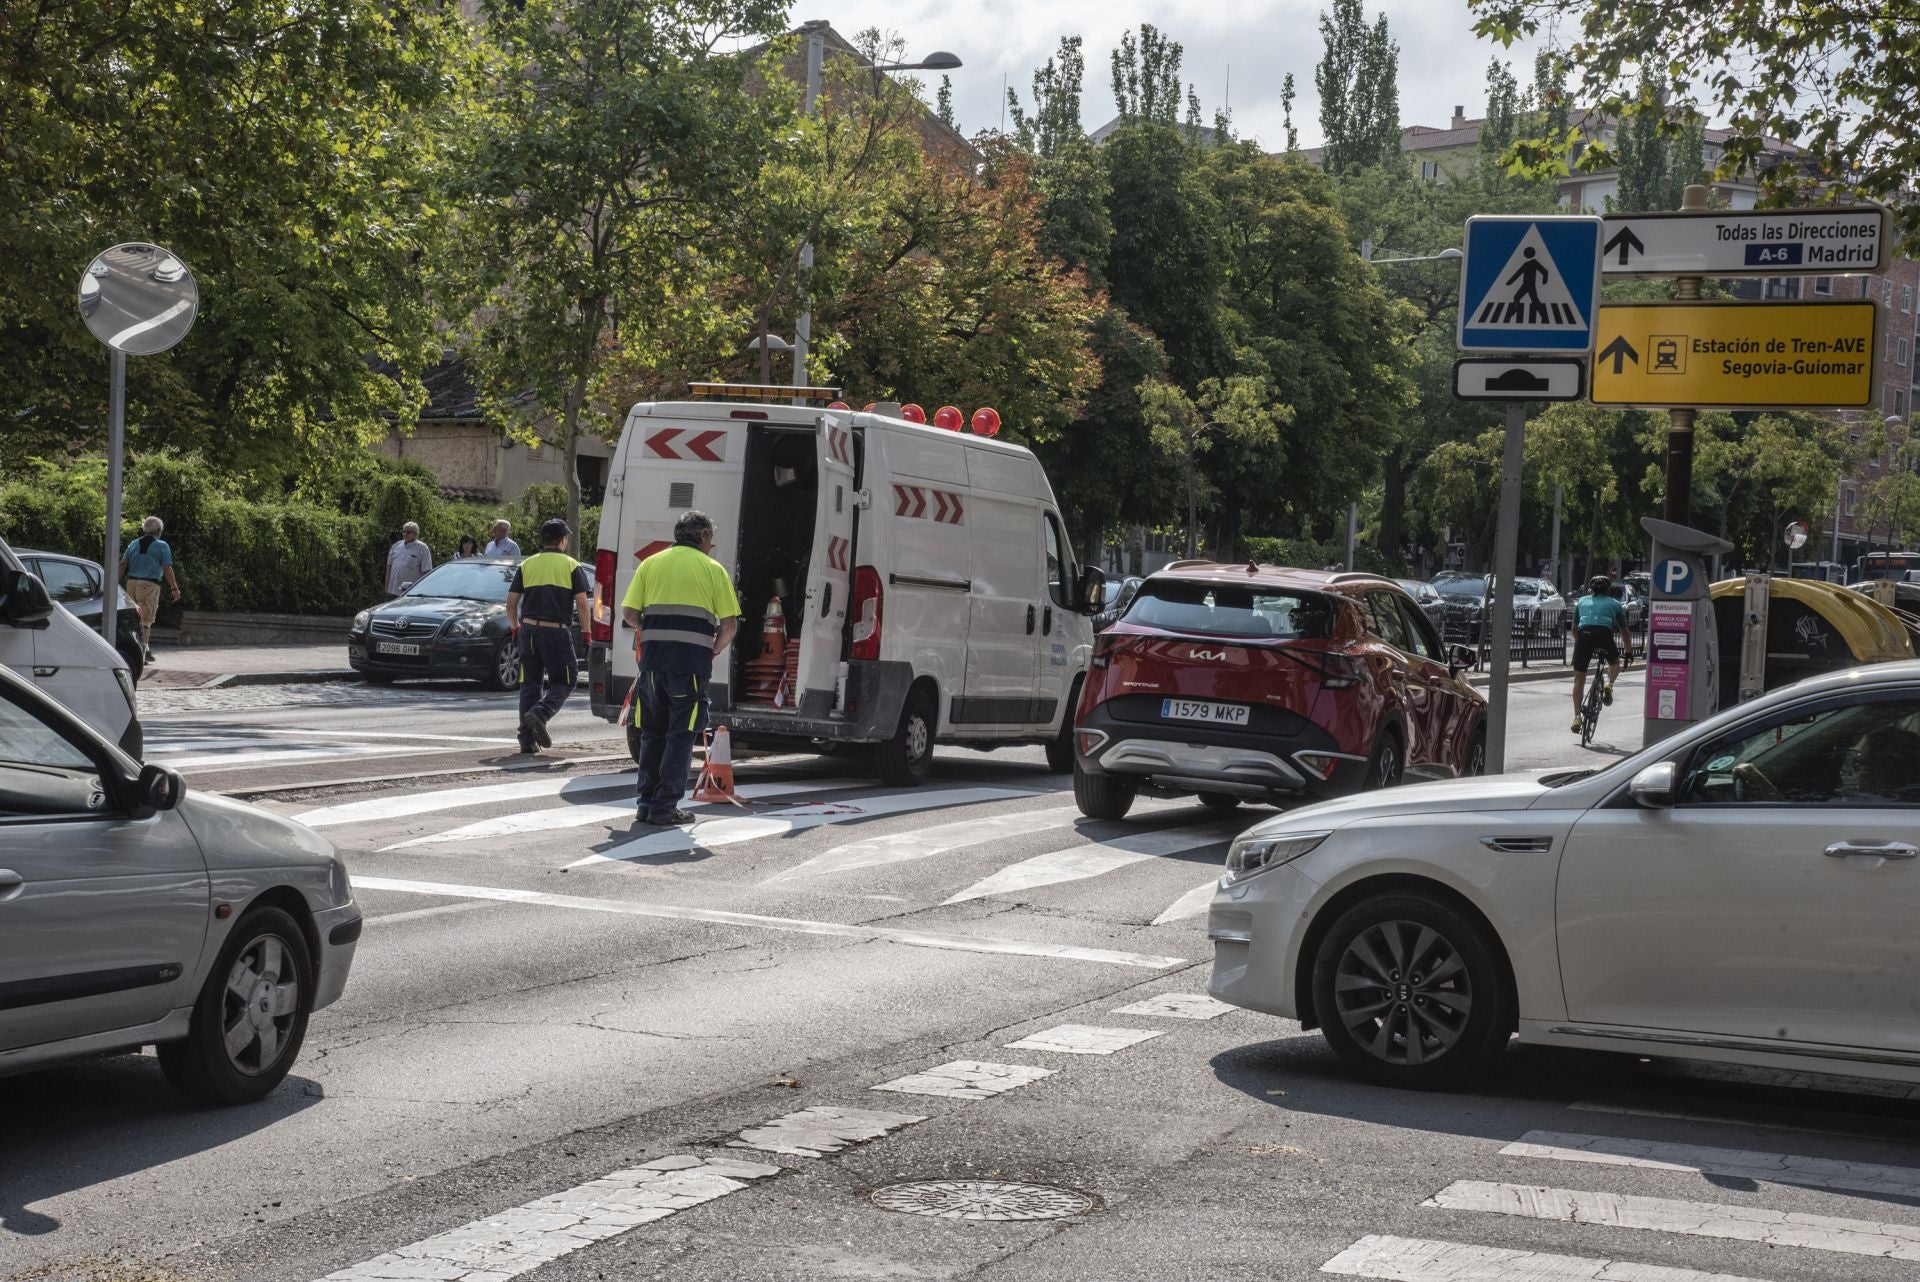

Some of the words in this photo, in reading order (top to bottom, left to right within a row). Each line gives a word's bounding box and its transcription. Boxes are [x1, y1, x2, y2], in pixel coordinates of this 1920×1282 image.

[1716, 224, 1757, 241] Todas
[1762, 223, 1783, 240] las
[1788, 221, 1876, 239] Direcciones
[1759, 248, 1788, 261] A-6
[1808, 244, 1874, 262] Madrid
[1693, 337, 1760, 353] Estación
[1766, 338, 1785, 353] de
[1791, 338, 1866, 353] Tren-AVE
[1722, 359, 1865, 378] Segovia-Guiomar
[1665, 560, 1689, 592] P
[381, 643, 401, 653] 2096
[1190, 650, 1226, 661] KIA
[1175, 703, 1209, 718] 1579
[1215, 705, 1246, 721] MKP
